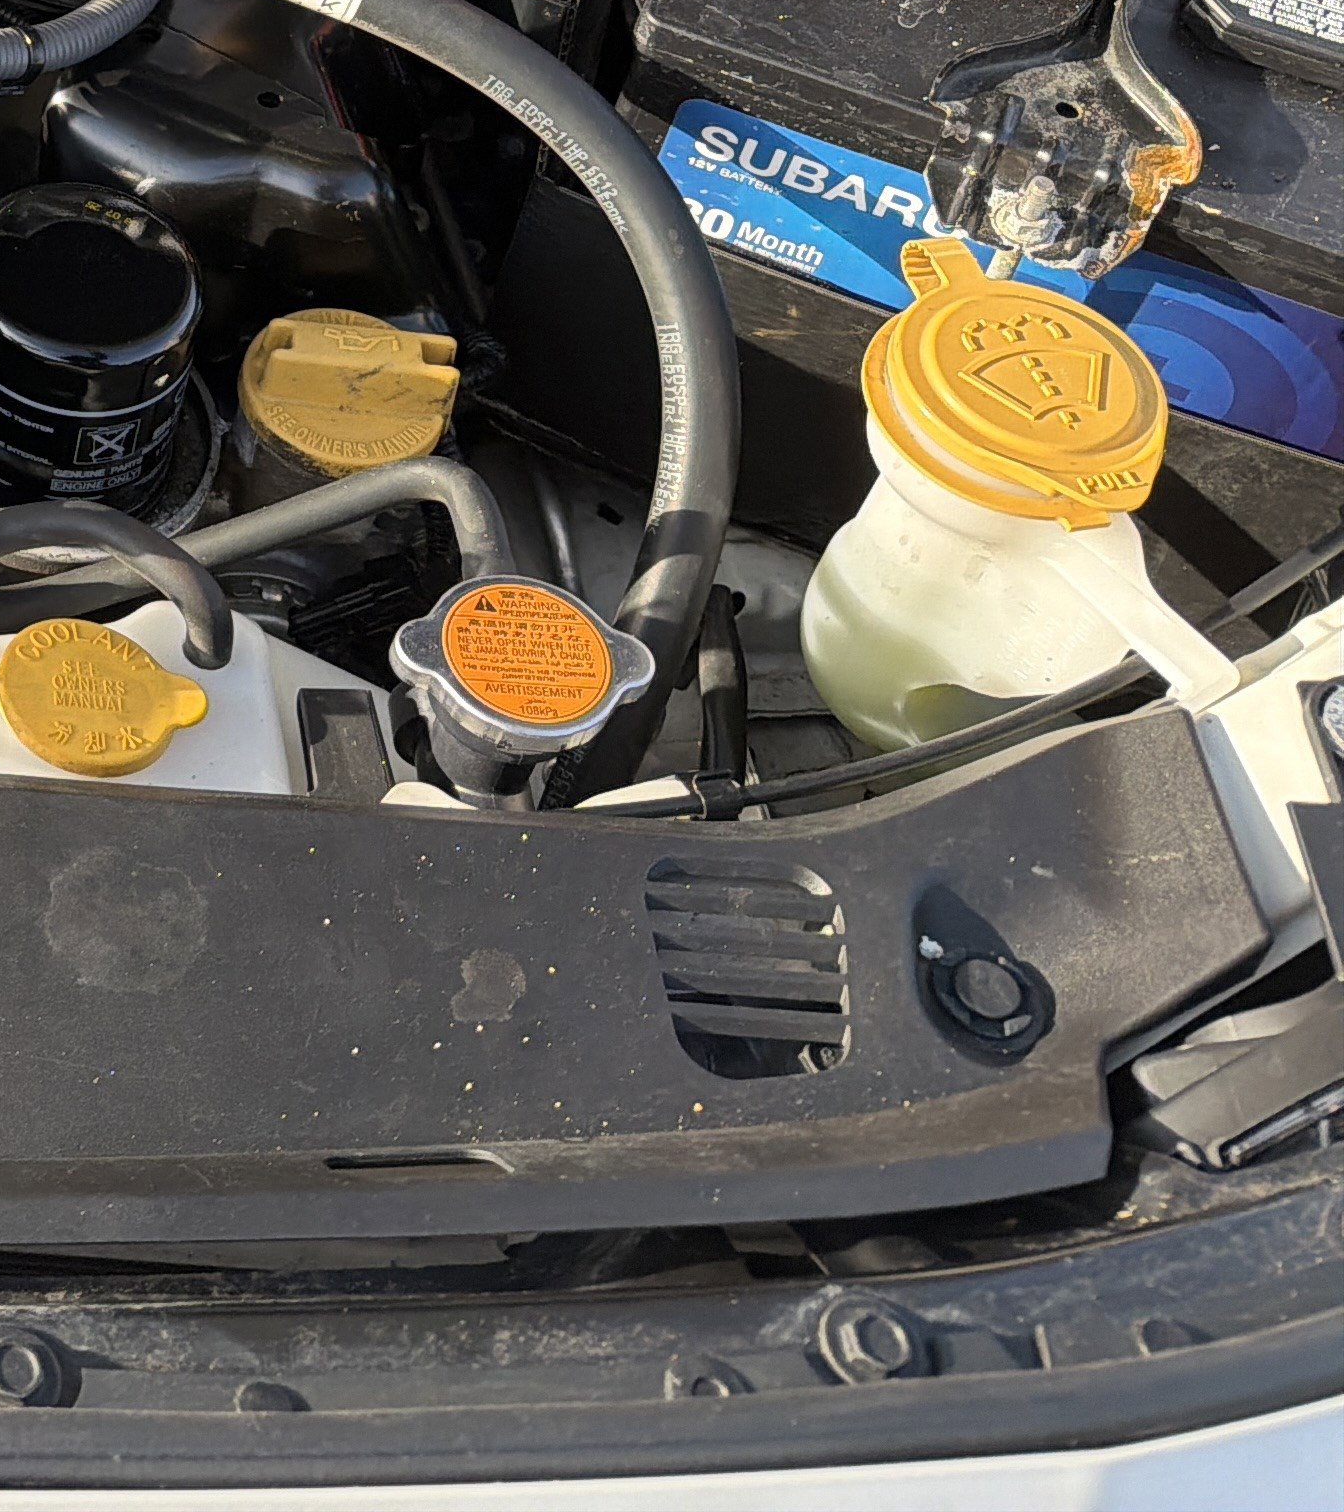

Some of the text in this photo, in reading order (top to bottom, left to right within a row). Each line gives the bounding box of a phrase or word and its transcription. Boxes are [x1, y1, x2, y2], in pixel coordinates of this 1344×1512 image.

[687, 156, 783, 196] 12V BATTERY
[736, 220, 824, 267] Month
[266, 403, 432, 459] SEE OWNER'S MANUAL
[53, 456, 143, 479] GENUINE PARTS
[53, 467, 141, 491] ENGINE ONLY
[1076, 470, 1146, 495] PULL
[497, 599, 561, 612] WARNING
[14, 622, 158, 672] COOLANT
[457, 635, 493, 646] NEVER
[496, 637, 526, 648] OPEN
[530, 639, 564, 651] WHEN
[460, 643, 472, 653] NE
[474, 645, 509, 656] JAMAIS
[61, 659, 97, 677] SEE
[51, 673, 127, 696] OWNERS
[484, 682, 584, 700] AVERTISSEMENT
[53, 689, 126, 713] MANUAL
[519, 704, 559, 718] 108kPa
